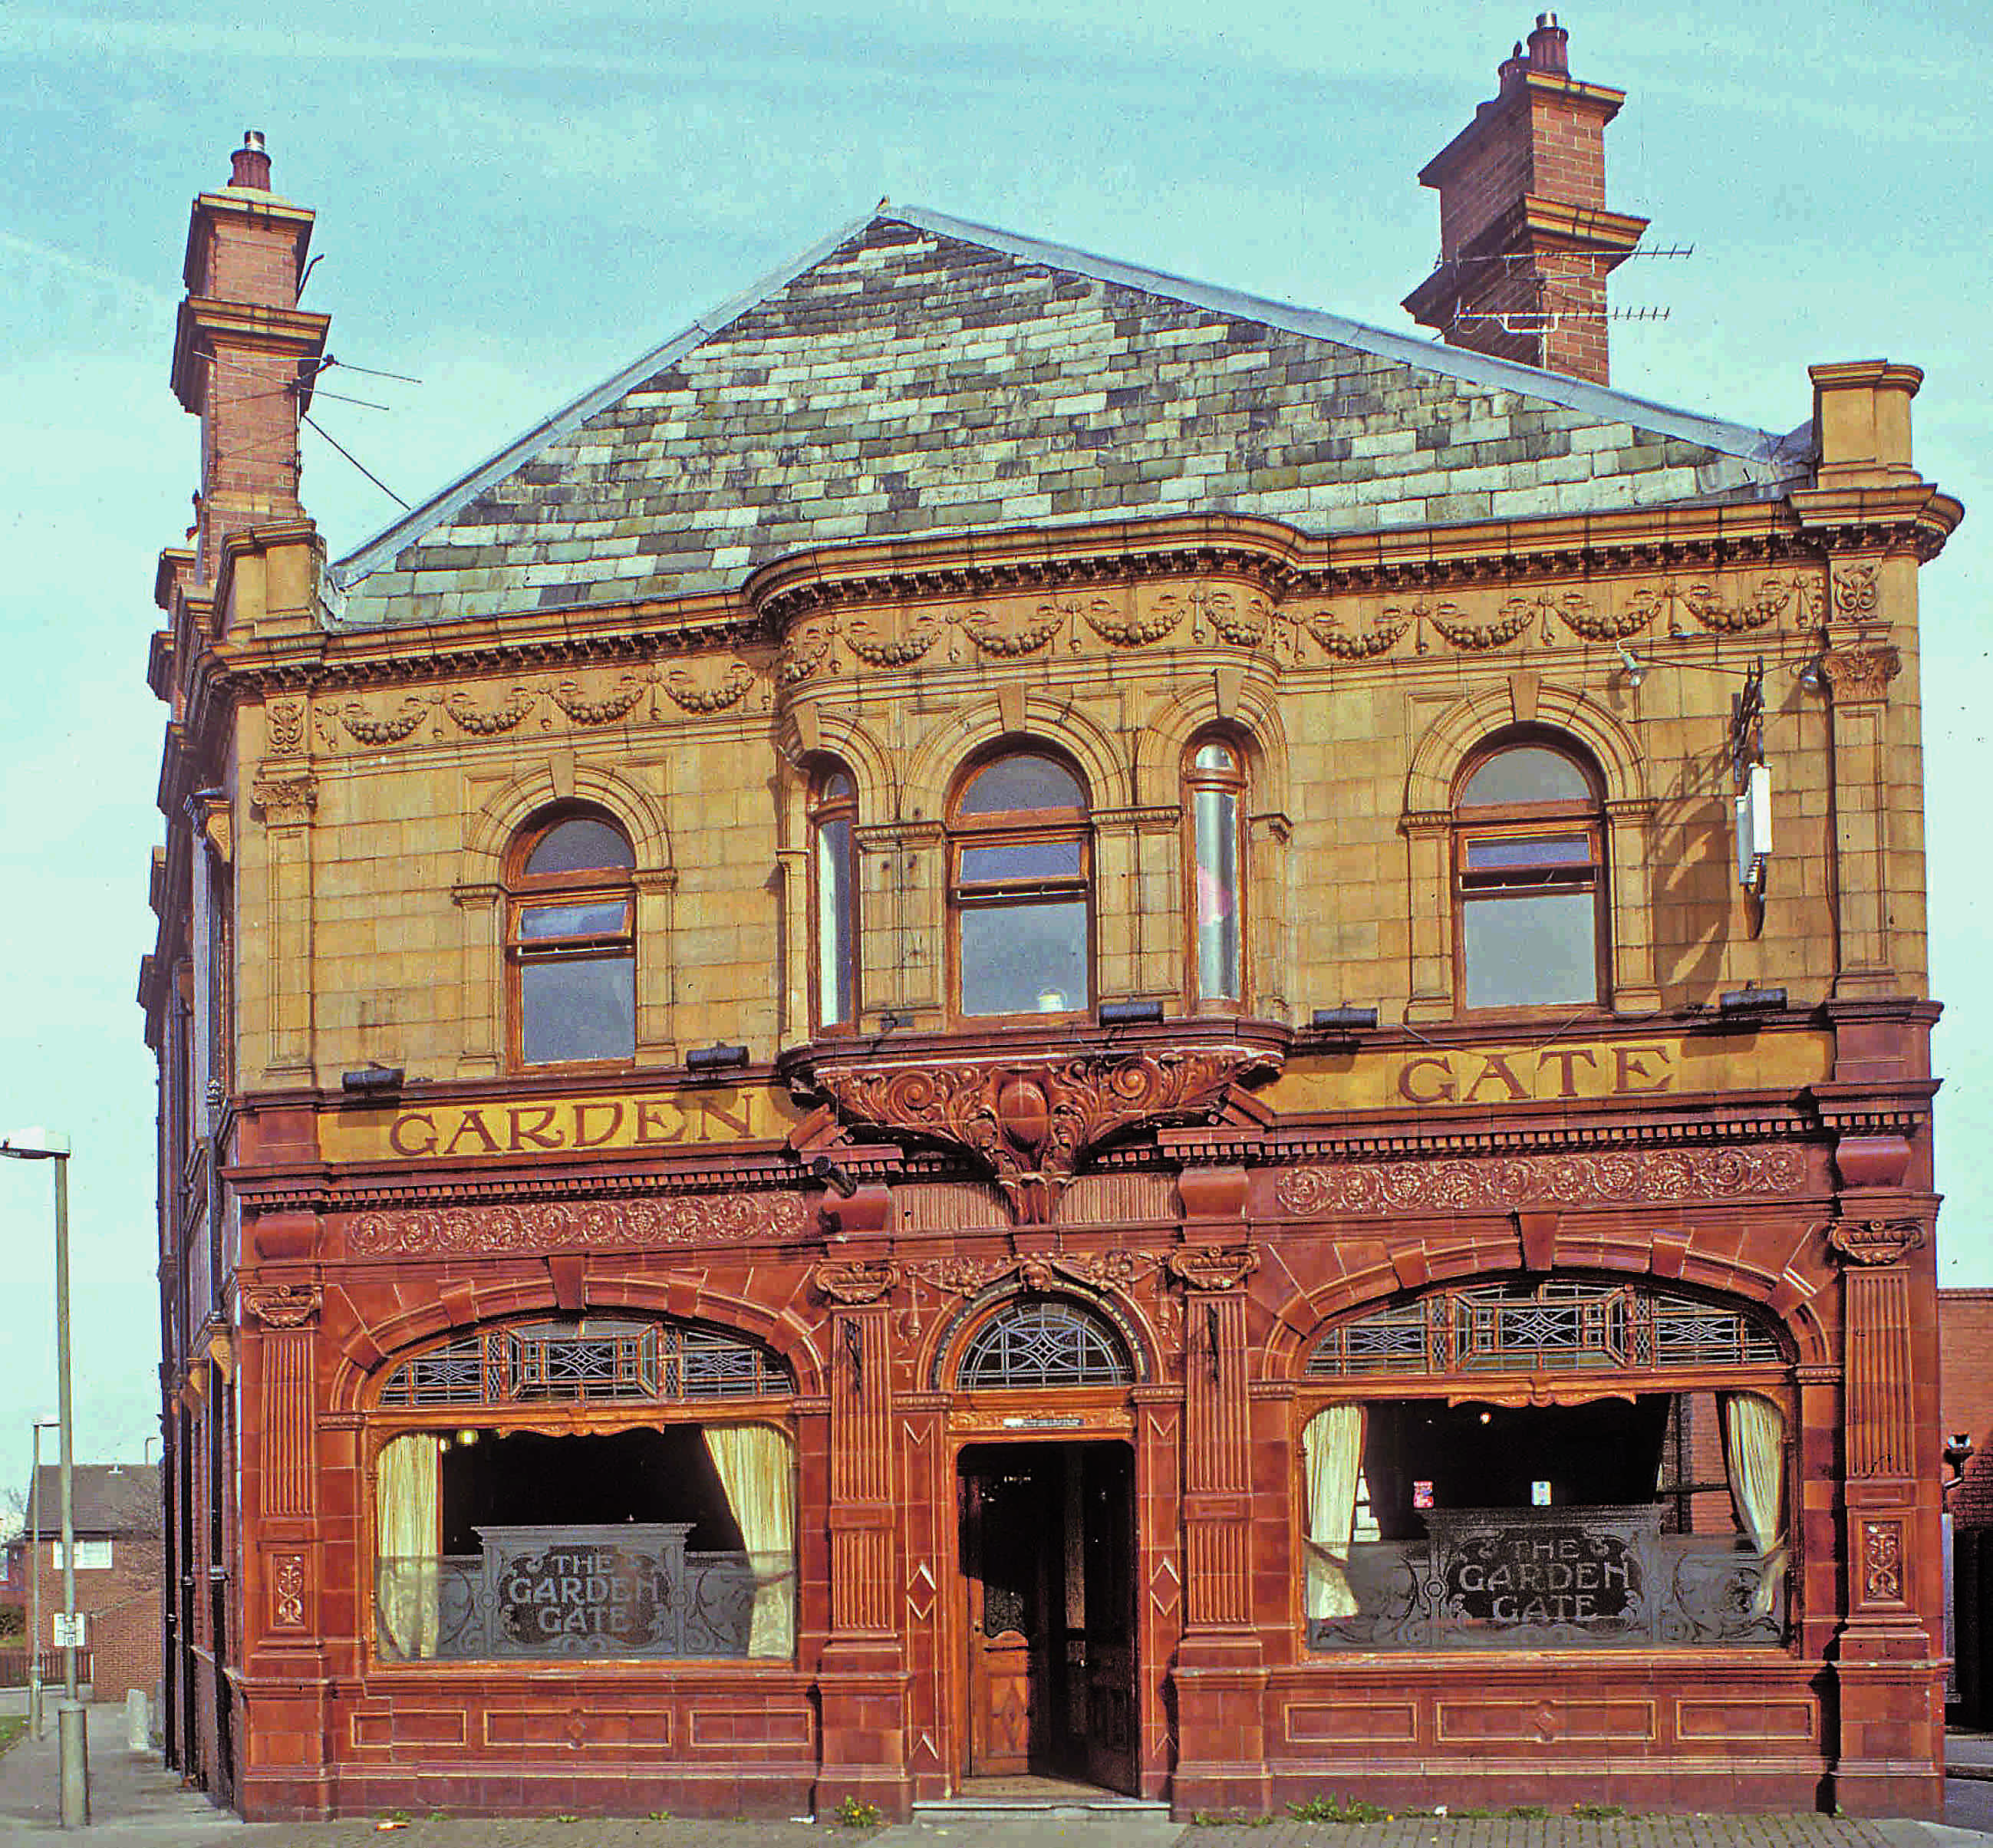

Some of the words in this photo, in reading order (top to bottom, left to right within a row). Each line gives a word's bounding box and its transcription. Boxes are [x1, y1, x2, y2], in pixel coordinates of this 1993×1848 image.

[1398, 1046, 1674, 1103] GATE
[390, 1094, 756, 1156] GARDEN
[1507, 1539, 1580, 1560] THE
[552, 1554, 612, 1573] THE
[1458, 1562, 1629, 1592] GARDEN
[509, 1576, 659, 1604] GARDEN
[539, 1606, 636, 1633] GATE
[1493, 1595, 1598, 1622] GATE
